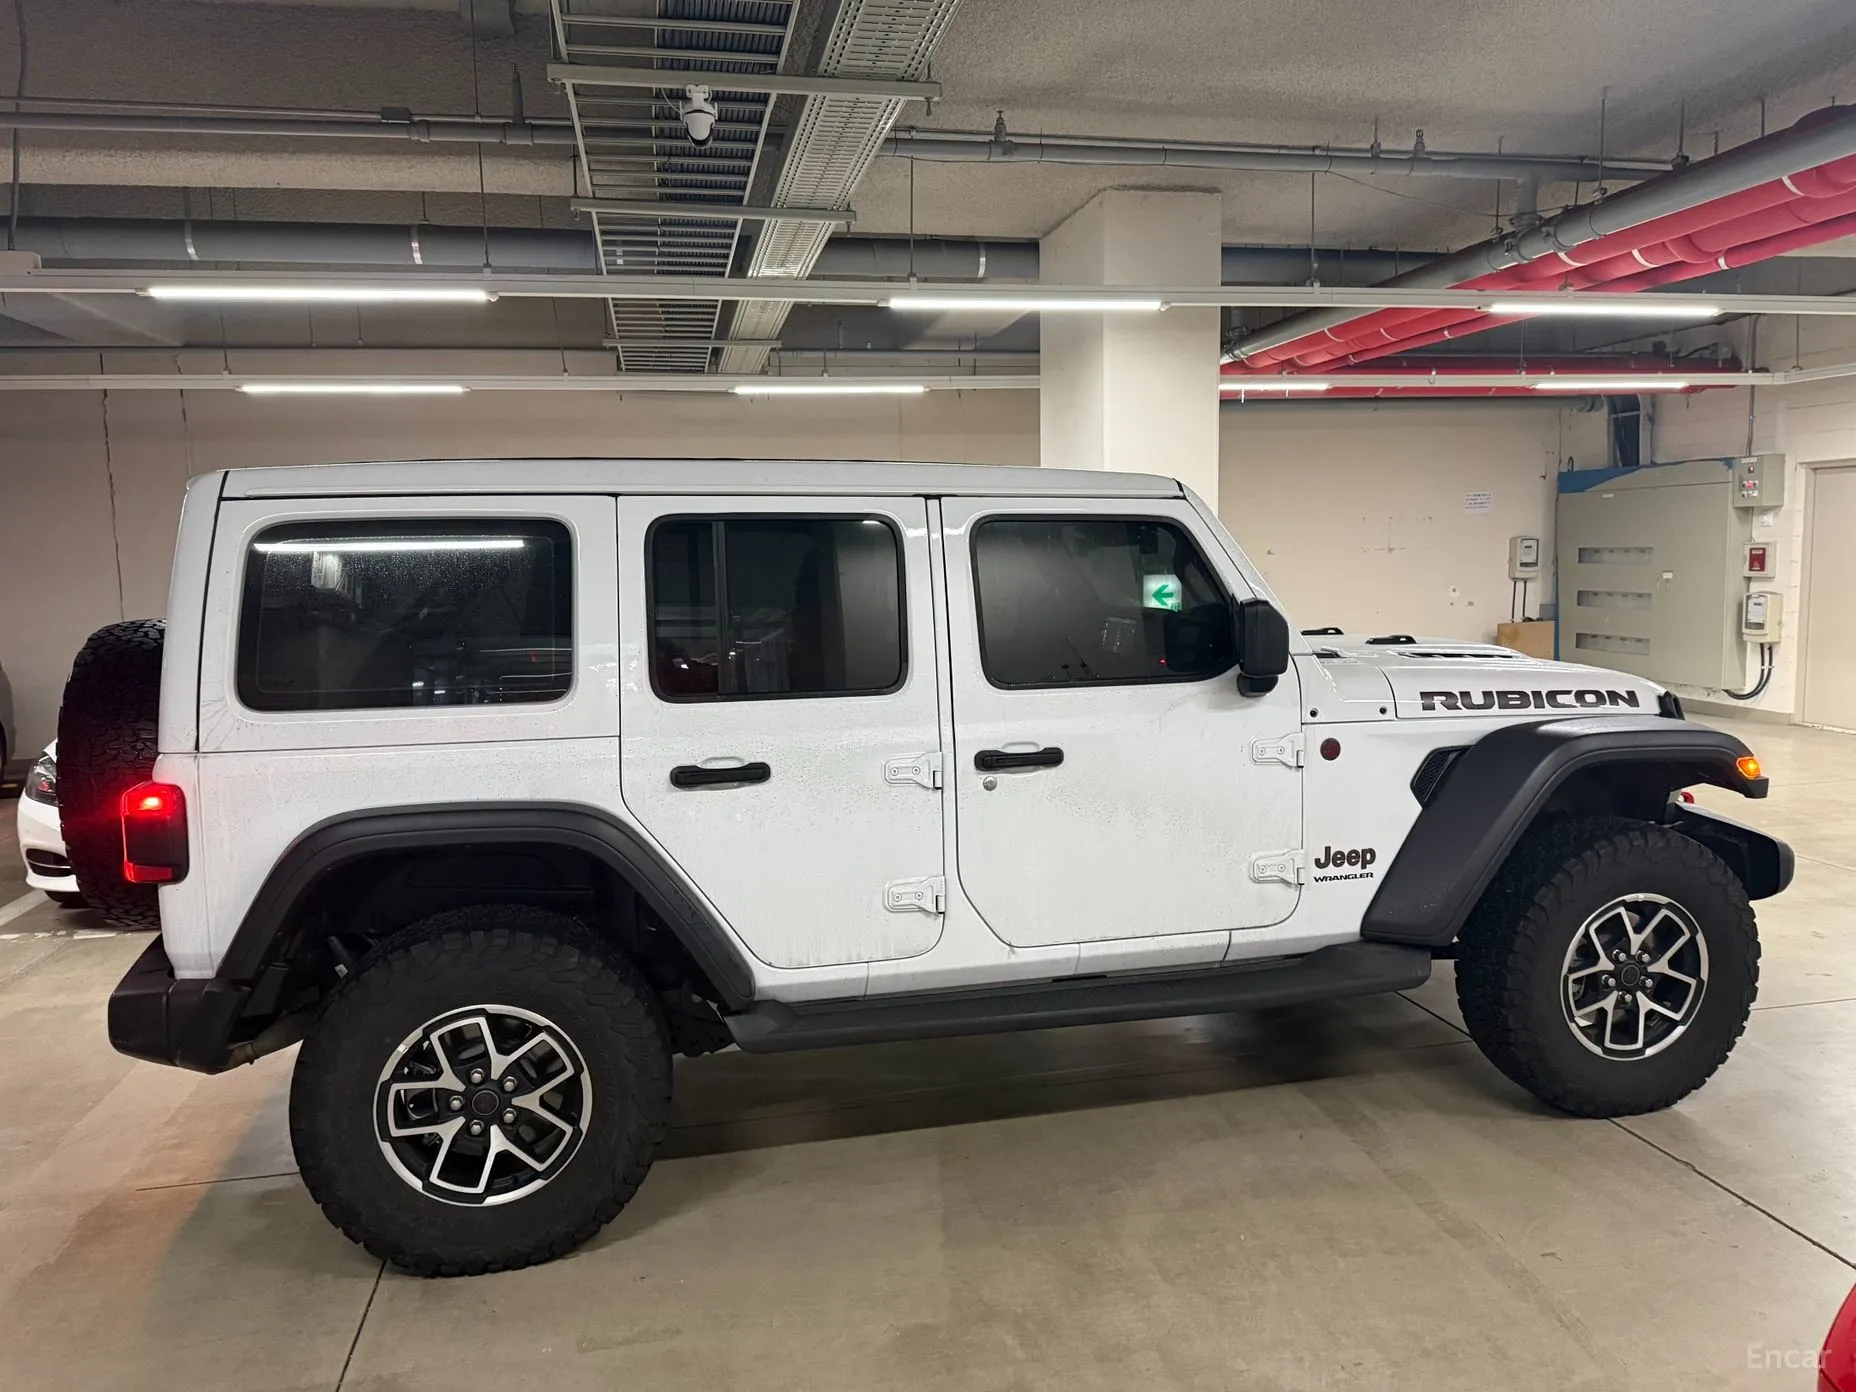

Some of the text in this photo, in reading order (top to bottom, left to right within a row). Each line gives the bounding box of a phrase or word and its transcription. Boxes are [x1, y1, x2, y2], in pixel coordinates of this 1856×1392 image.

[1419, 690, 1640, 711] RUBICON
[1314, 846, 1376, 869] Jeep
[1314, 872, 1374, 883] WRANGLER
